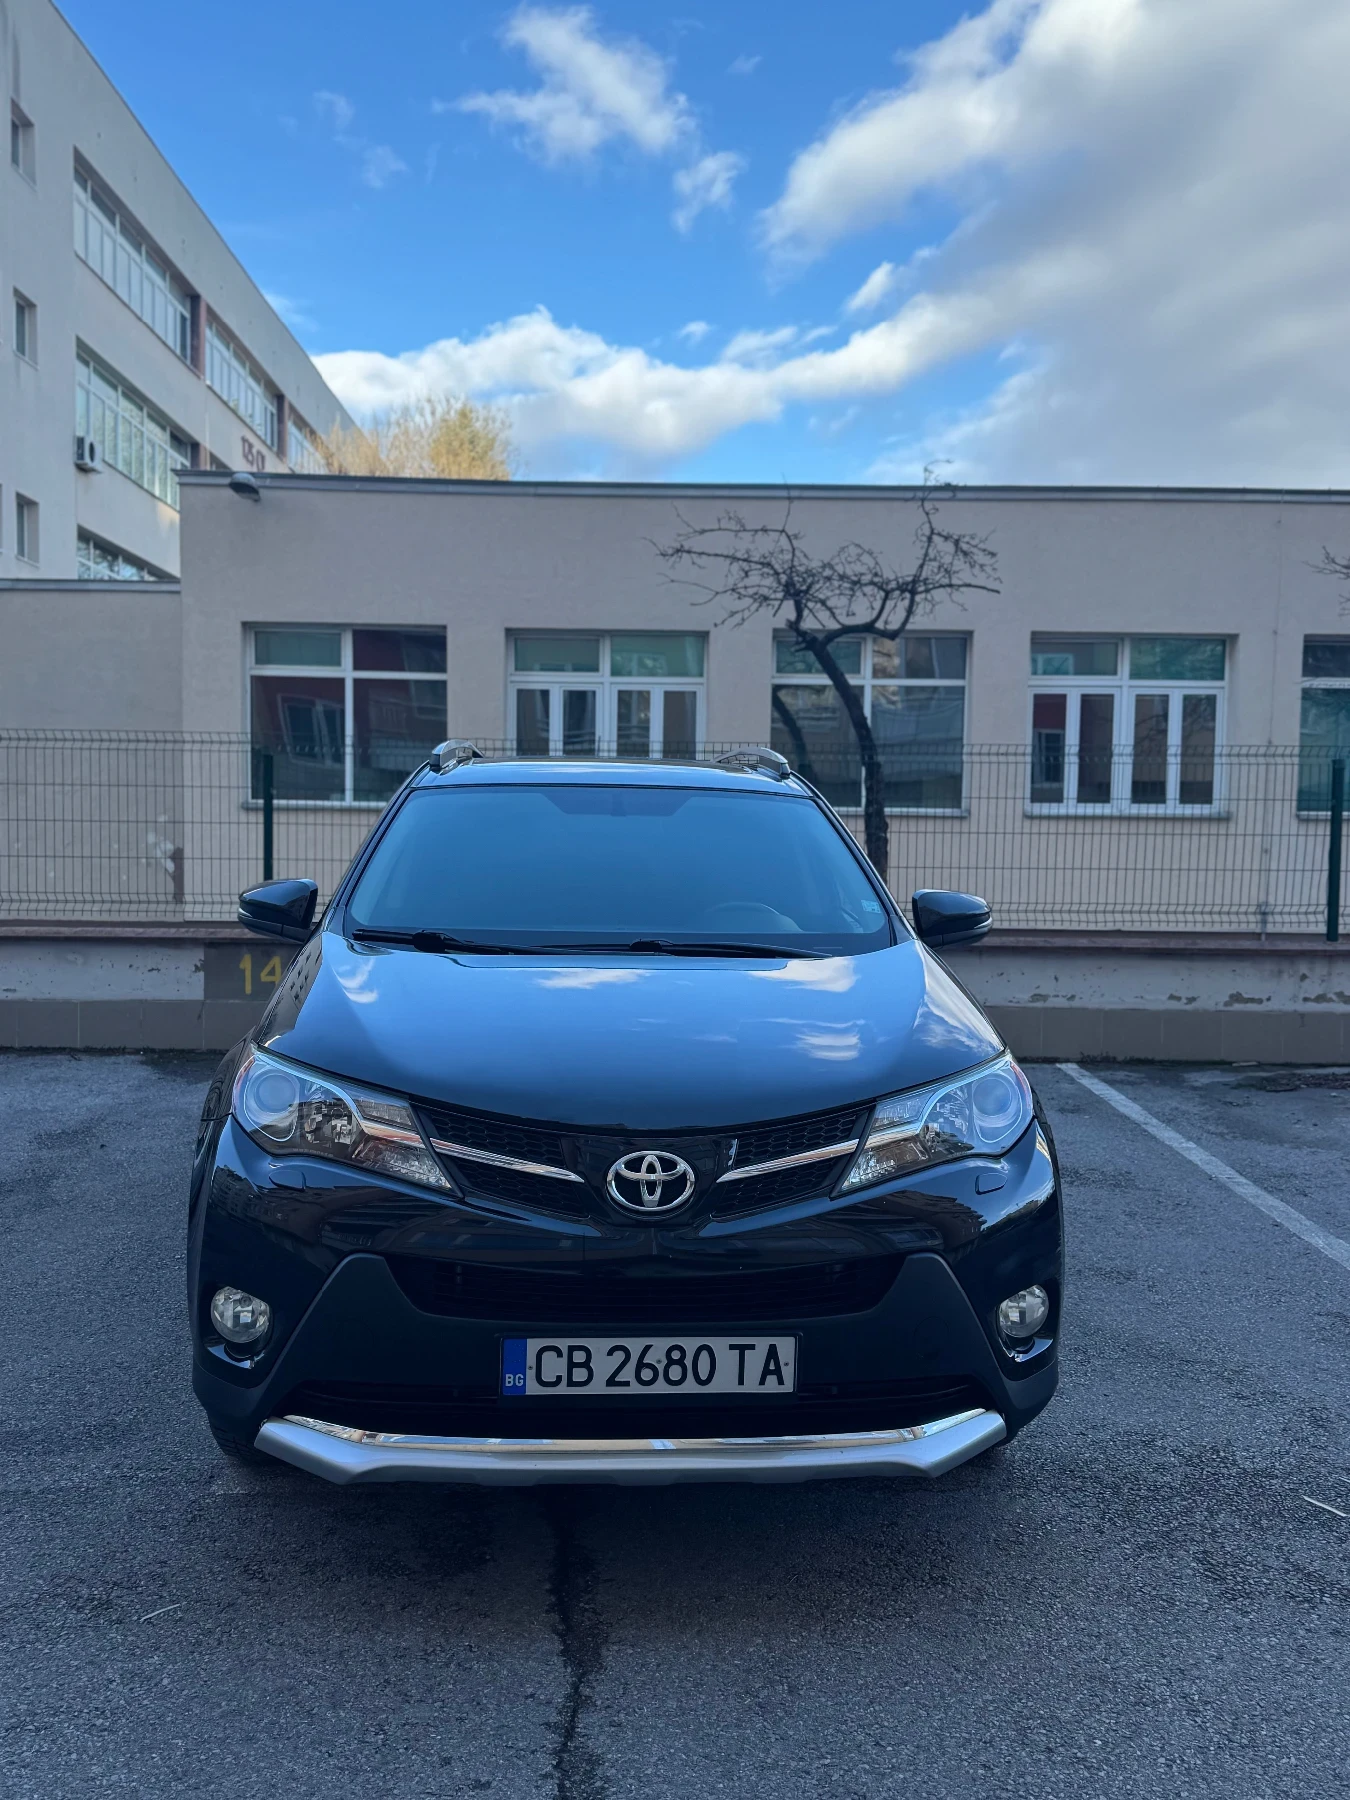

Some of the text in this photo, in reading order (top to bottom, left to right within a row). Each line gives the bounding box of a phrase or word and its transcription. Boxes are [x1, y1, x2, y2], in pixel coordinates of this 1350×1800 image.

[239, 954, 281, 995] 14
[505, 1374, 524, 1387] BG
[535, 1343, 785, 1388] CB 2680 TA
